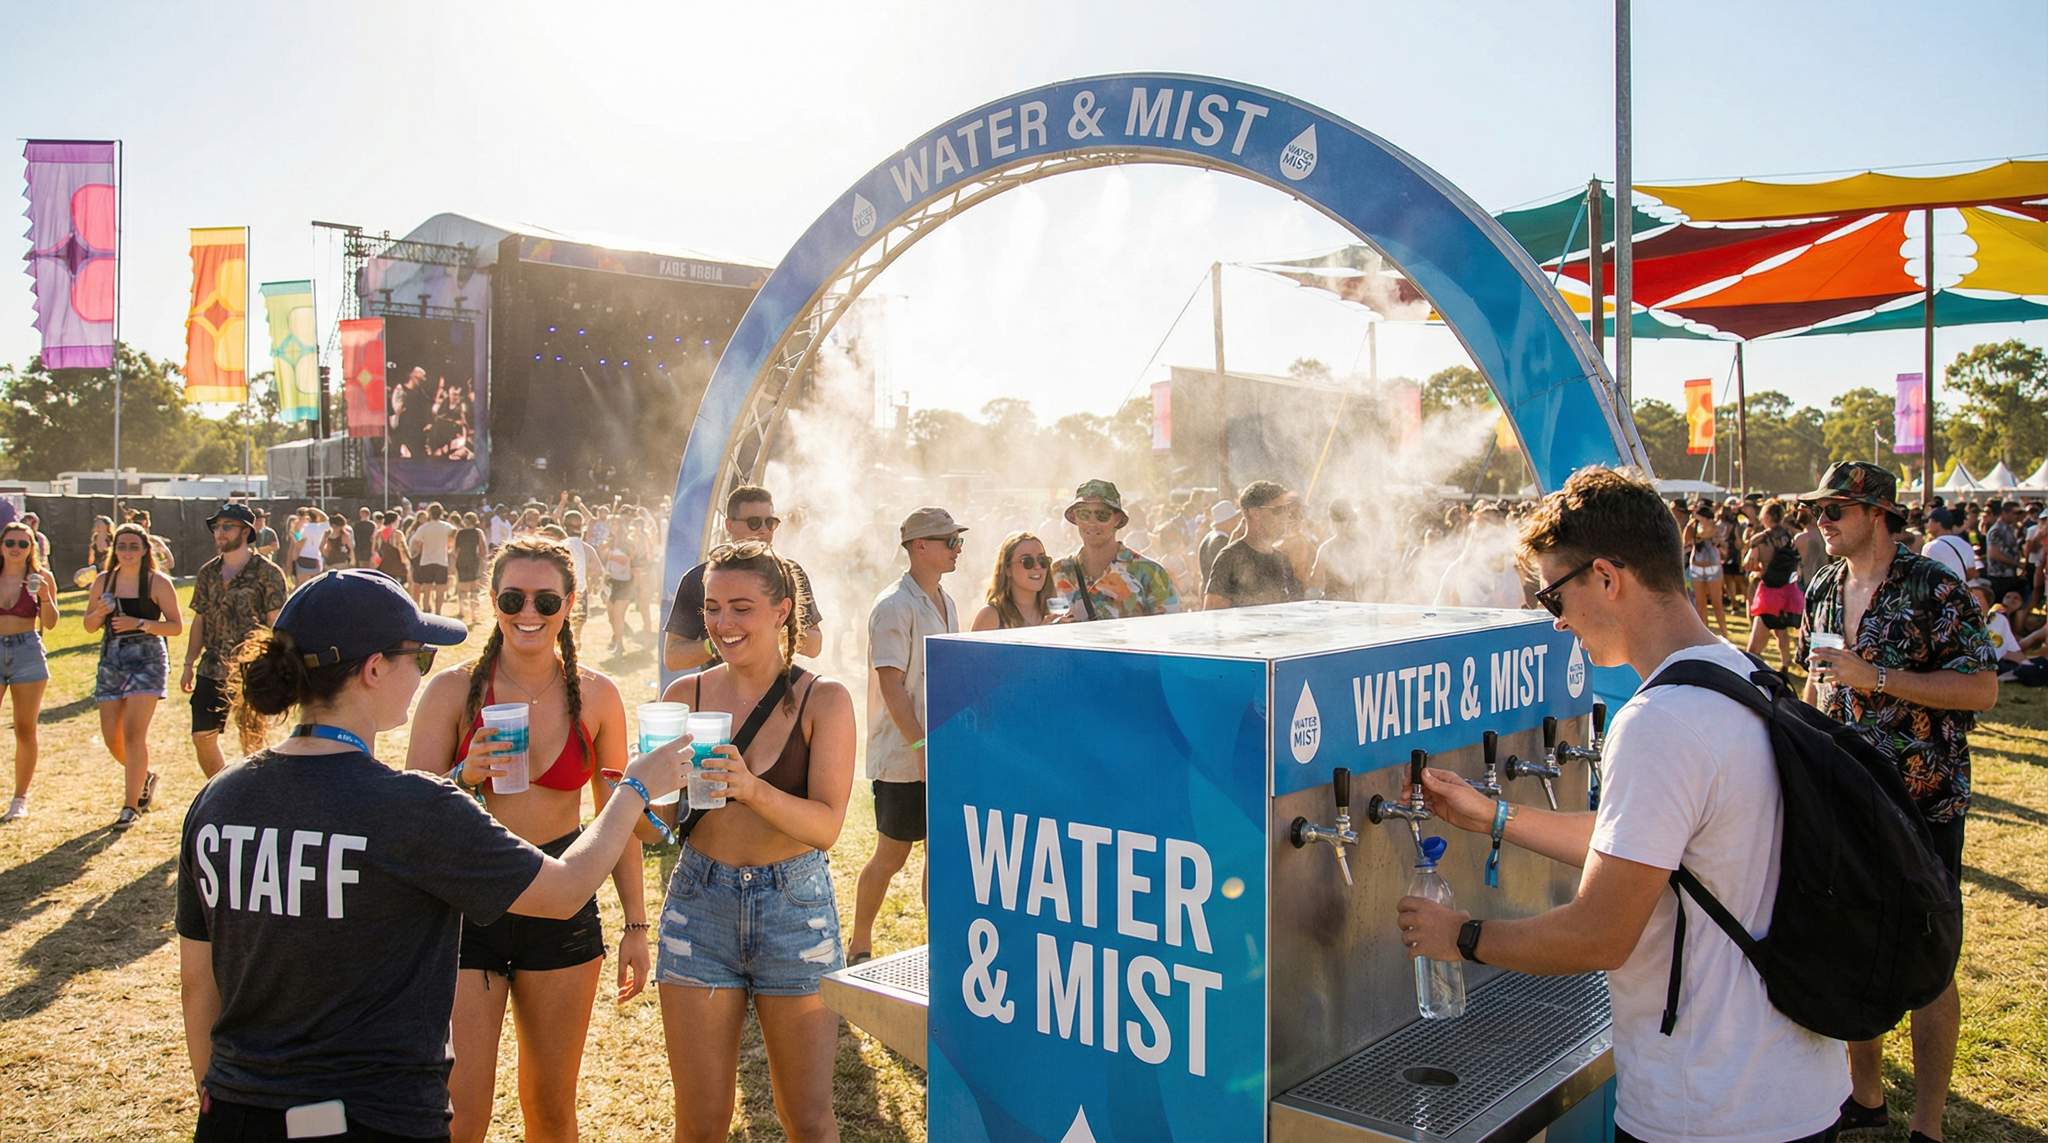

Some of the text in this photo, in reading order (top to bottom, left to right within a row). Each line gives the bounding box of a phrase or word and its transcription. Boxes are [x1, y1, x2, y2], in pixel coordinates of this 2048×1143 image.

[889, 87, 1270, 203] WATER & MIST
[1282, 153, 1312, 172] MIST
[1294, 728, 1317, 748] MIST
[1353, 644, 1548, 746] WATER & MIST
[196, 823, 368, 919] STAFF
[963, 804, 1213, 954] WATER
[962, 918, 1223, 1077] & MIST
